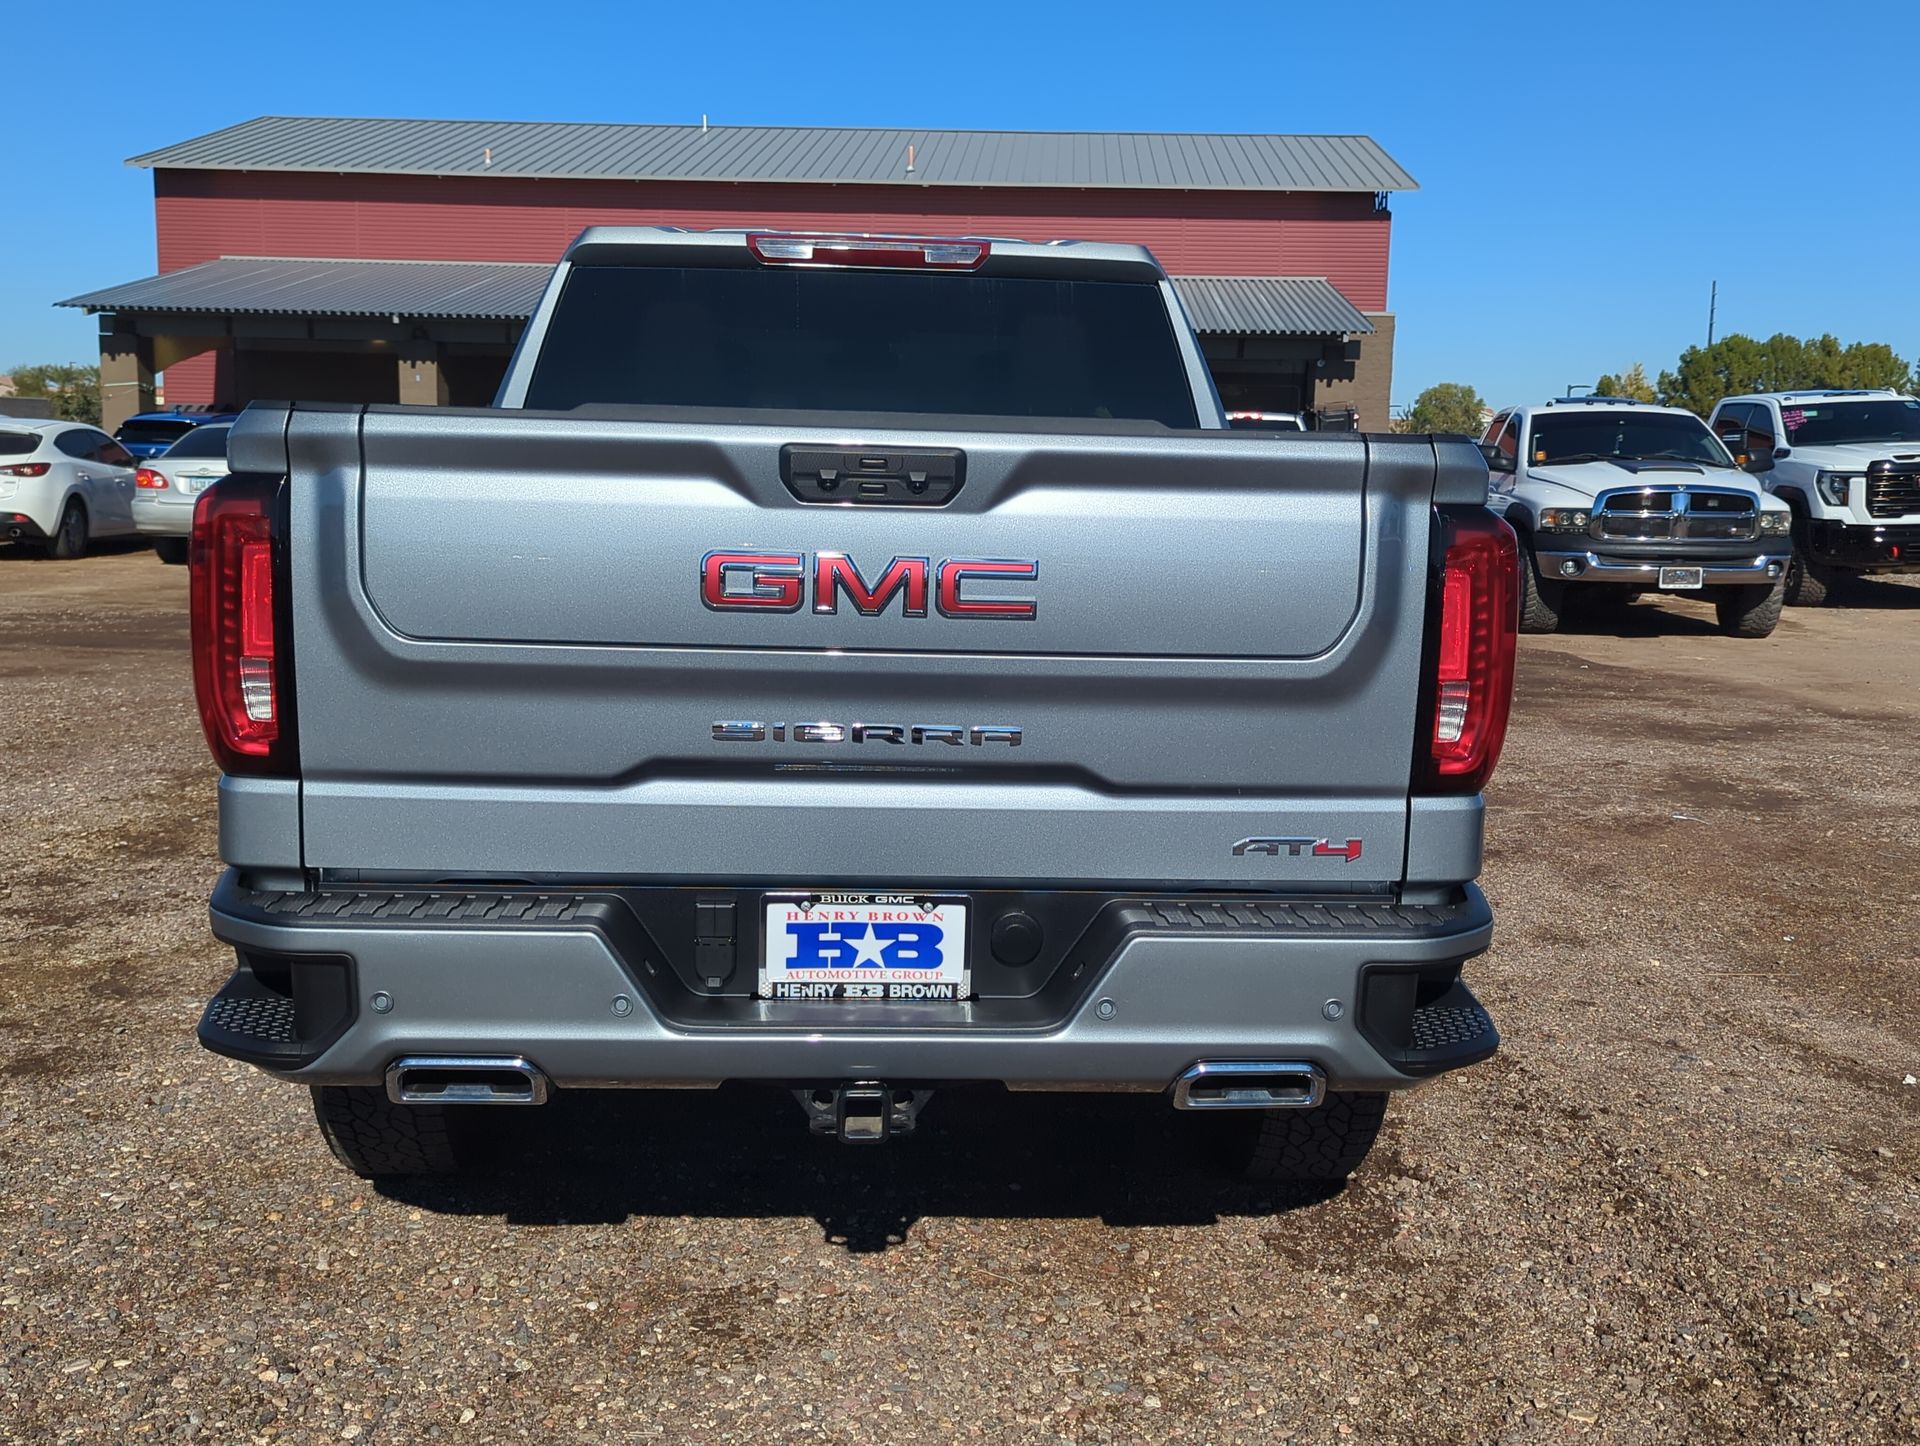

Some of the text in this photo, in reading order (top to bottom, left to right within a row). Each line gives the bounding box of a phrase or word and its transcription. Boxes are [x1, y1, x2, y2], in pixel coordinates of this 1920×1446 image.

[701, 549, 1039, 621] GMC
[711, 720, 1024, 747] SIERRA
[1232, 836, 1363, 863] AT4
[820, 894, 915, 904] BUICK GMC
[786, 911, 944, 922] HENRY BROWN
[786, 970, 943, 980] AUTOMOTIVE GROUP
[776, 983, 837, 997] HENRY
[889, 984, 953, 999] BROWN
